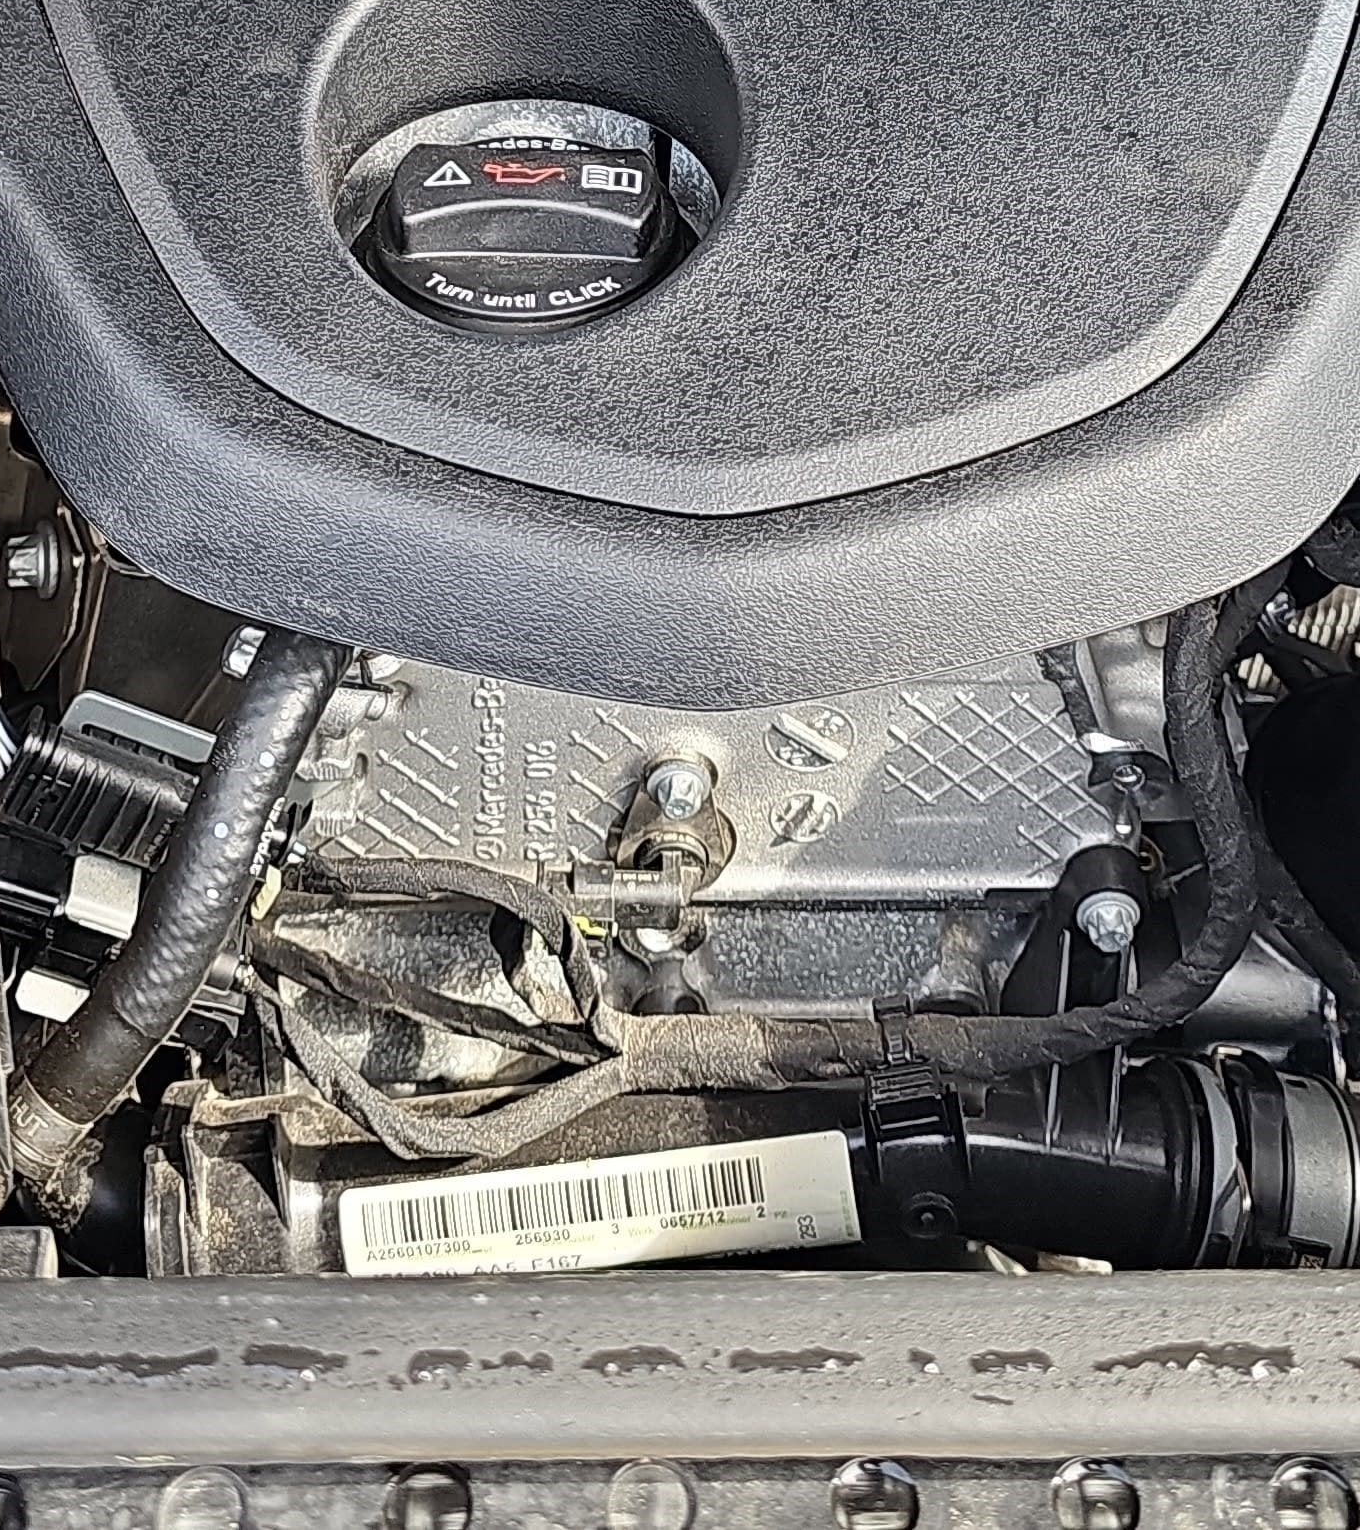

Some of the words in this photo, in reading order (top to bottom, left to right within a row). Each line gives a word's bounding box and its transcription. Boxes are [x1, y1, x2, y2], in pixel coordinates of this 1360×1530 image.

[425, 272, 474, 302] Turn
[483, 293, 536, 308] until
[548, 276, 622, 306] CLICK
[524, 789, 557, 833] 256
[611, 1222, 620, 1235] 3
[756, 1206, 766, 1219] 2
